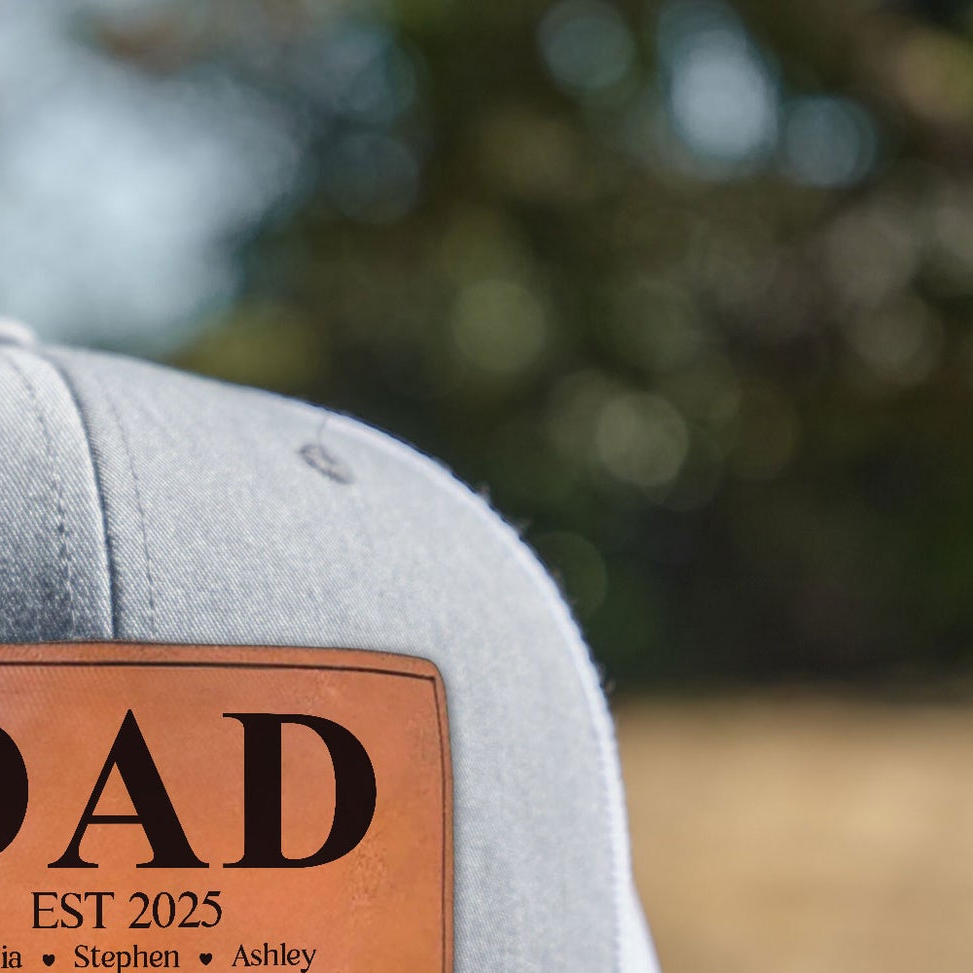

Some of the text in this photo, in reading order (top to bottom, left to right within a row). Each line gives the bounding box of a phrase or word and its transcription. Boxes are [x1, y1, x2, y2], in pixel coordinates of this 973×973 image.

[32, 891, 222, 929] EST 2025
[232, 943, 316, 973] Ashley
